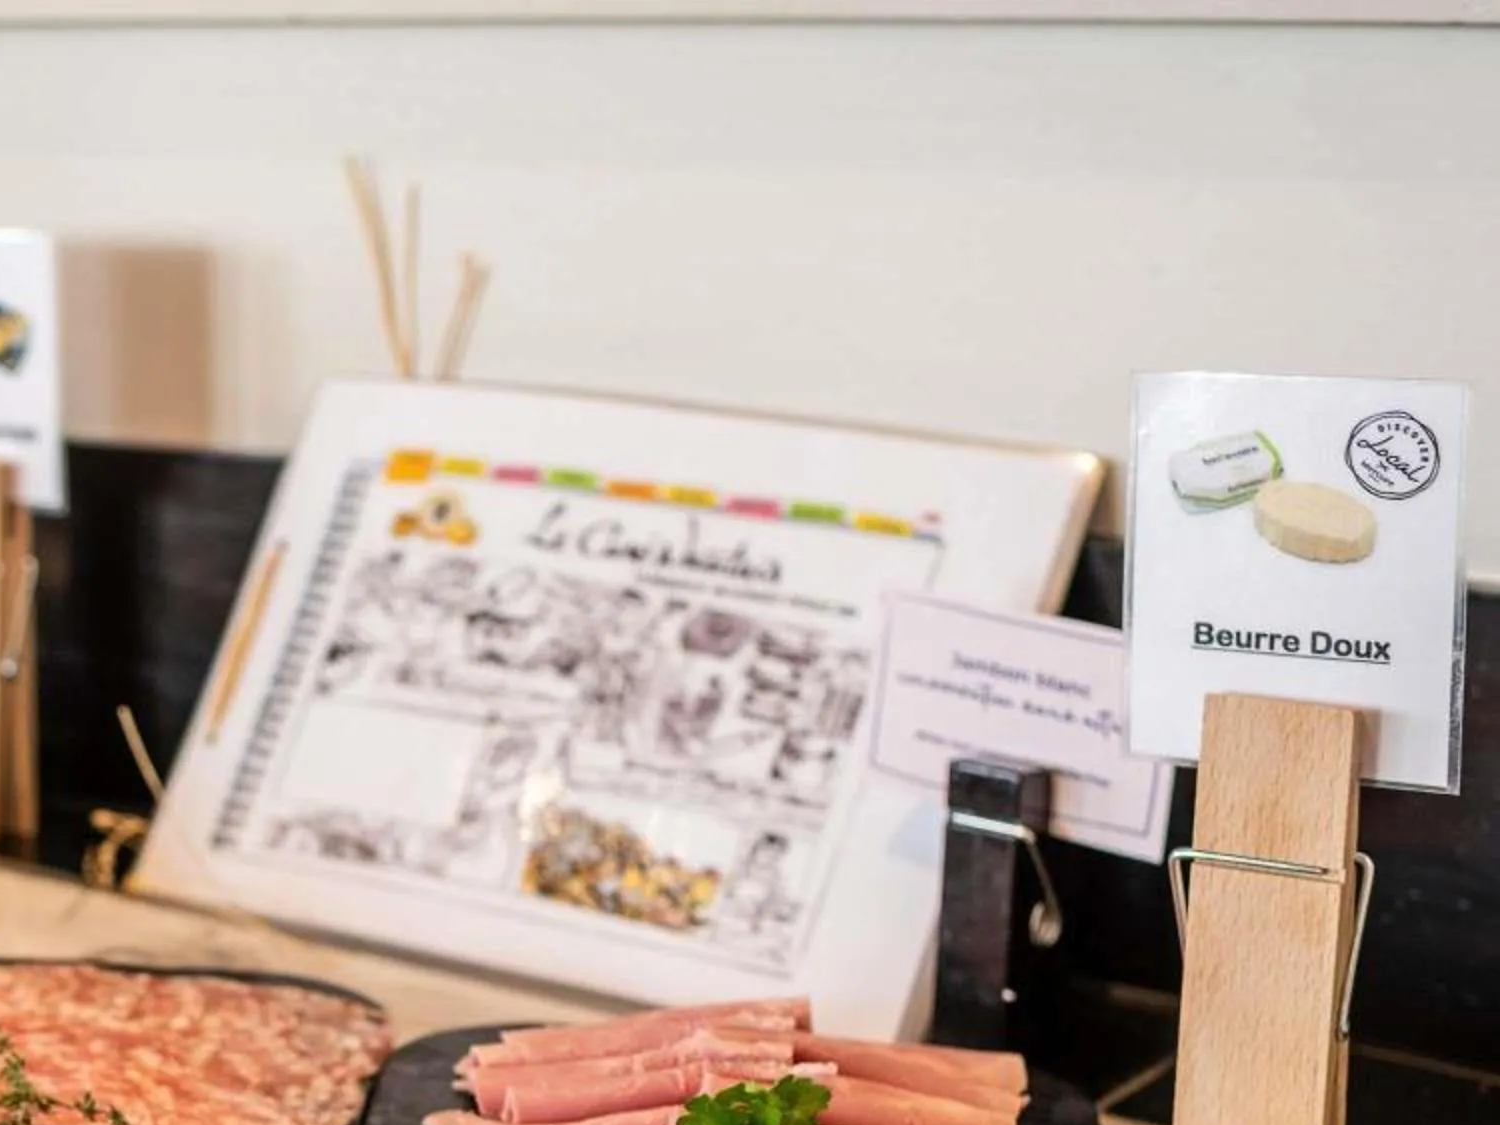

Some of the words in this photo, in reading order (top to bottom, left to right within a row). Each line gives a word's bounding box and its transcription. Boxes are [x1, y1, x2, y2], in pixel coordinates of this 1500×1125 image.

[1357, 435, 1427, 483] Local
[1377, 423, 1429, 463] DISCOVER
[1193, 621, 1301, 653] Beurre
[1310, 631, 1391, 661] Doux
